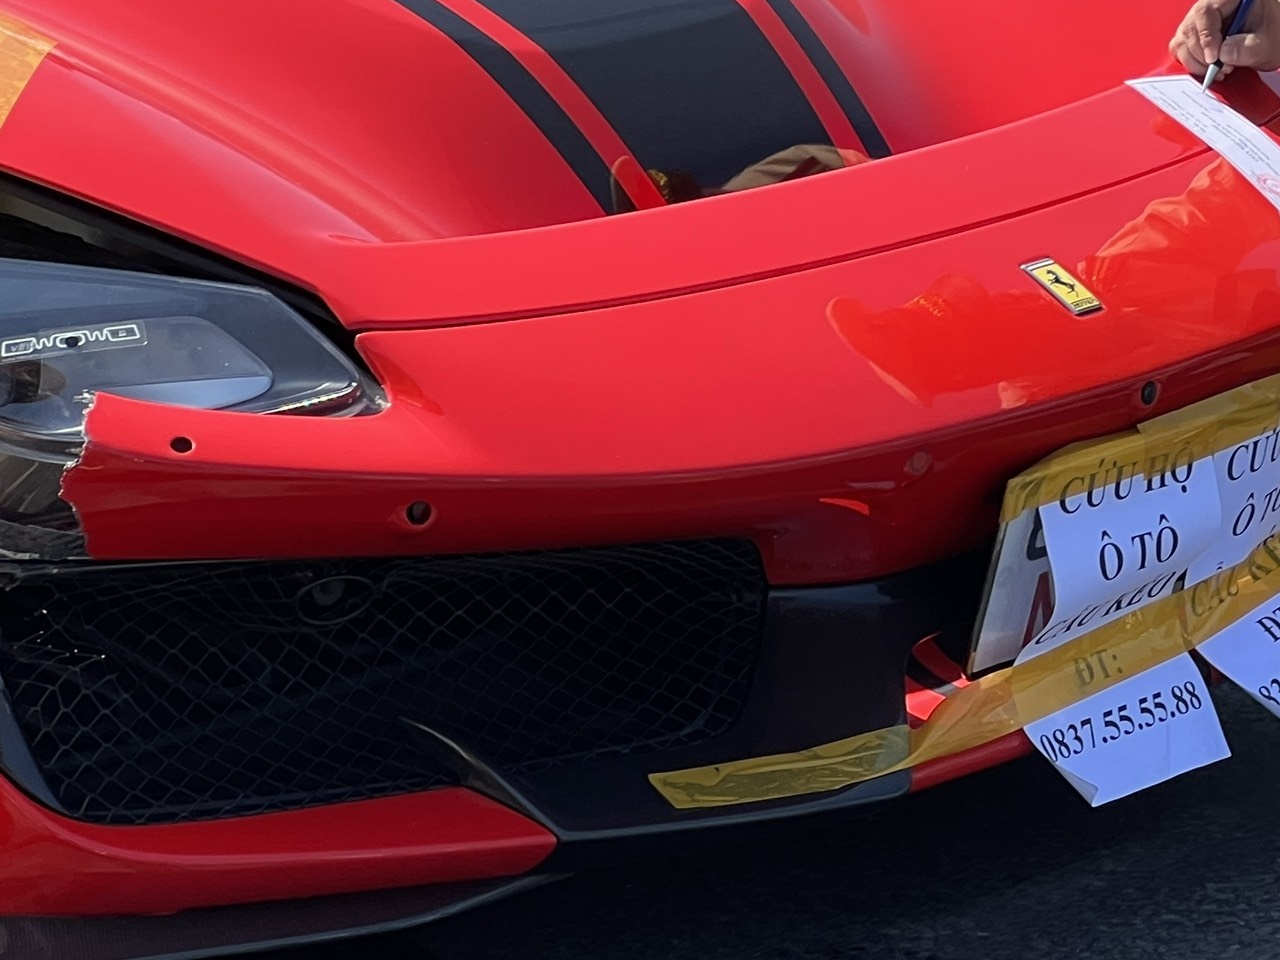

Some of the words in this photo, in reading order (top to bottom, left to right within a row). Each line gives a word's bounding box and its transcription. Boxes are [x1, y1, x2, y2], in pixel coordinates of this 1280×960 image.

[1059, 458, 1138, 514] CỨU
[1144, 443, 1194, 493] HỘ
[1099, 530, 1124, 581] Ô
[1131, 513, 1179, 571] TÔ
[1232, 492, 1255, 537] Ô
[1073, 649, 1123, 686] ĐT:
[1040, 681, 1202, 763] 0837.55.55.88
